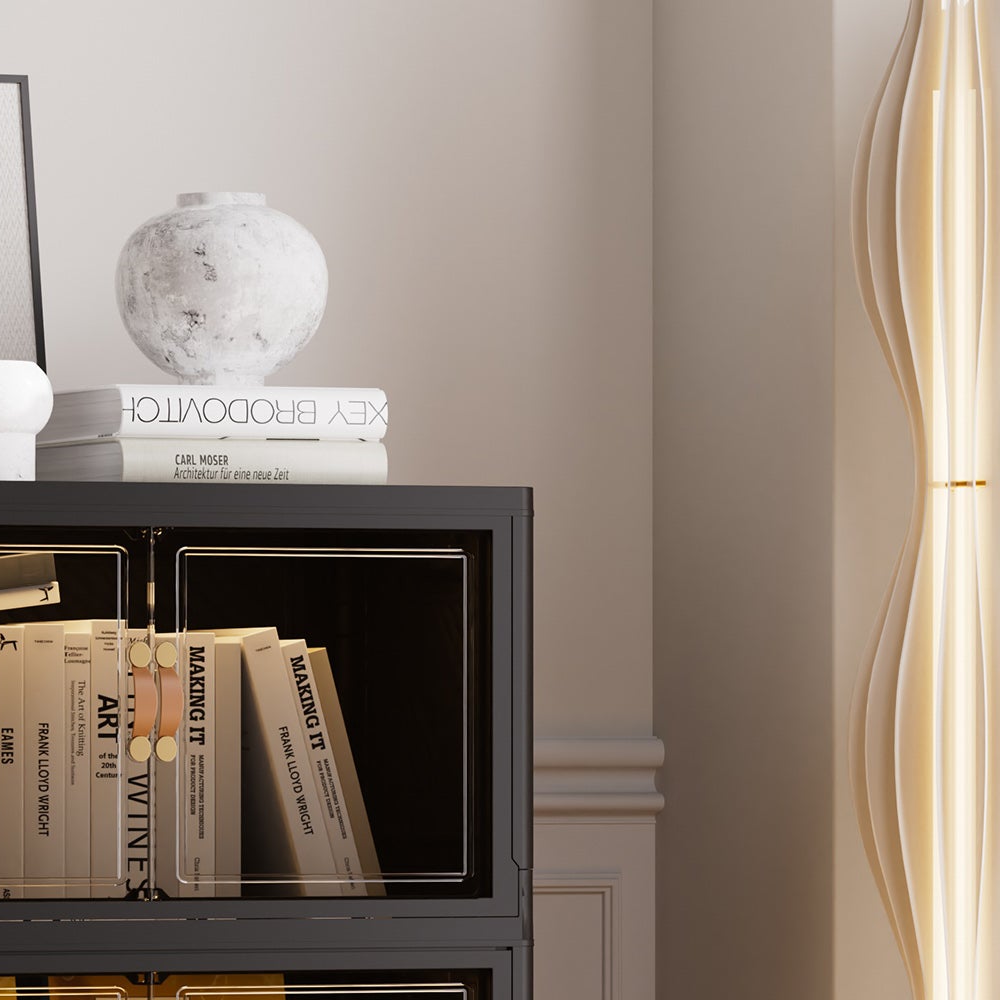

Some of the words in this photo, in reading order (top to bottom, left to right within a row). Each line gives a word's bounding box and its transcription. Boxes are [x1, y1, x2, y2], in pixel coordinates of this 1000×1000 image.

[329, 400, 388, 426] XEY
[174, 466, 219, 481] Architektur
[220, 467, 232, 481] für
[233, 468, 250, 480] eine
[252, 470, 272, 481] neue
[273, 469, 289, 481] Zeit
[175, 454, 197, 466] CARL
[199, 454, 229, 466] MOSER
[78, 680, 86, 696] The
[189, 646, 205, 721] MAKING
[78, 697, 86, 711] Art
[78, 713, 86, 721] of
[98, 693, 119, 744] ART
[290, 655, 320, 729] MAKING
[309, 732, 326, 752] IT
[1, 727, 14, 765] EAMES
[38, 722, 49, 754] FRANK
[76, 723, 86, 757] Knitting
[189, 727, 205, 746] IT
[278, 726, 295, 759] FRANK
[38, 756, 49, 792] LLOYD
[287, 760, 304, 794] LLOYD
[38, 794, 49, 837] WRIGHT
[294, 795, 314, 836] WRIGHT
